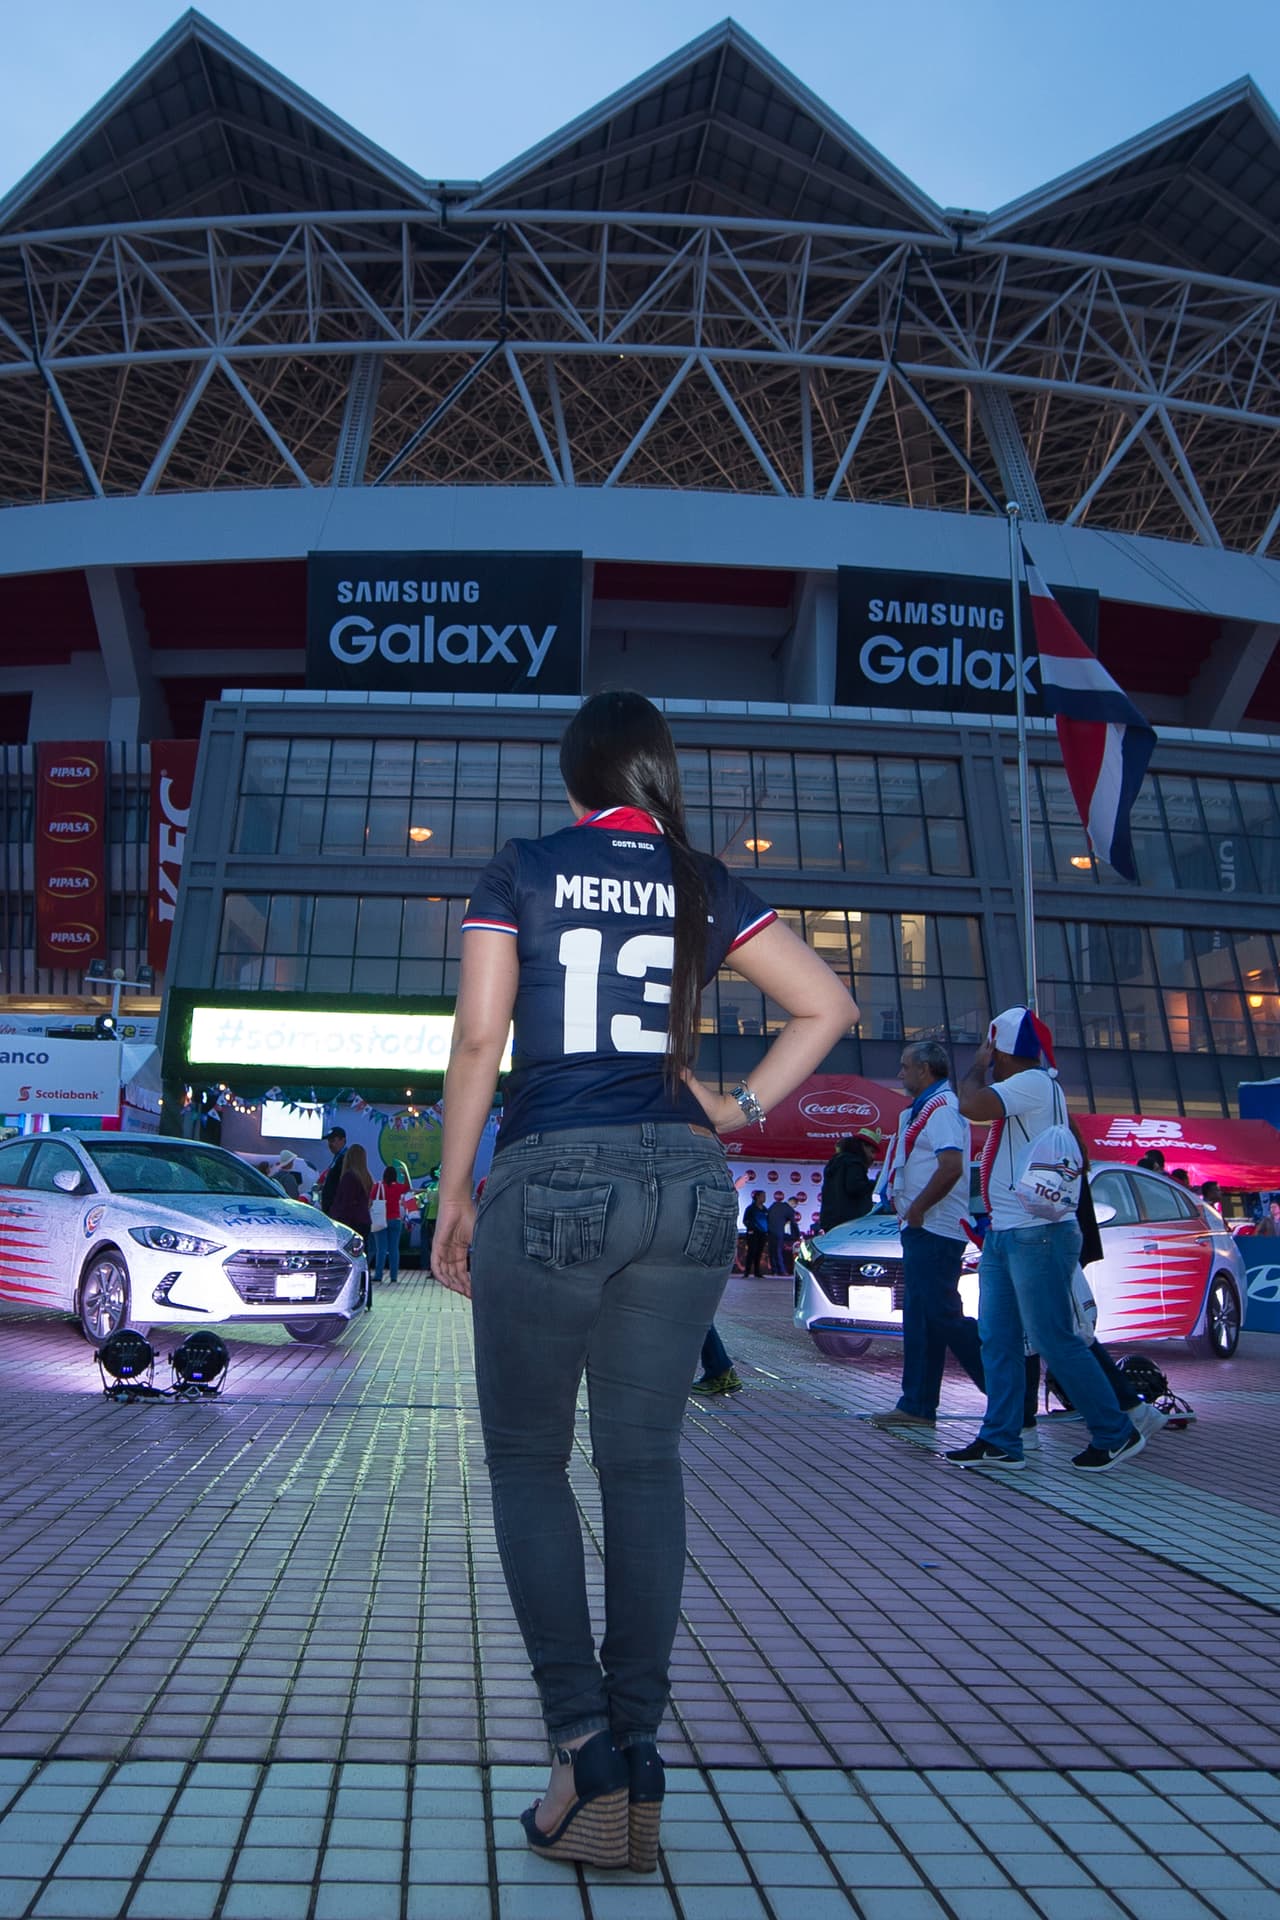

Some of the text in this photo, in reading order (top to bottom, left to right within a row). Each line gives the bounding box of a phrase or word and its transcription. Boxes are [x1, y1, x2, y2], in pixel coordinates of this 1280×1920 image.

[337, 580, 480, 603] SAMSUNG
[868, 599, 1004, 630] SAMSUNG
[329, 615, 558, 677] Galaxy
[859, 634, 1038, 695] Galax
[50, 767, 91, 778] PIPASA
[49, 822, 90, 833] PIPASA
[612, 840, 655, 851] COSTA RICA
[49, 878, 89, 888] PIPASA
[555, 874, 676, 918] MERLYN
[50, 932, 91, 943] PIPASA
[558, 927, 675, 1055] 13
[0, 1051, 49, 1064] anco
[35, 1089, 99, 1100] Scotiabank
[1105, 1118, 1184, 1139] NB
[1094, 1138, 1217, 1151] new balance
[223, 1215, 321, 1229] HYUNDAI
